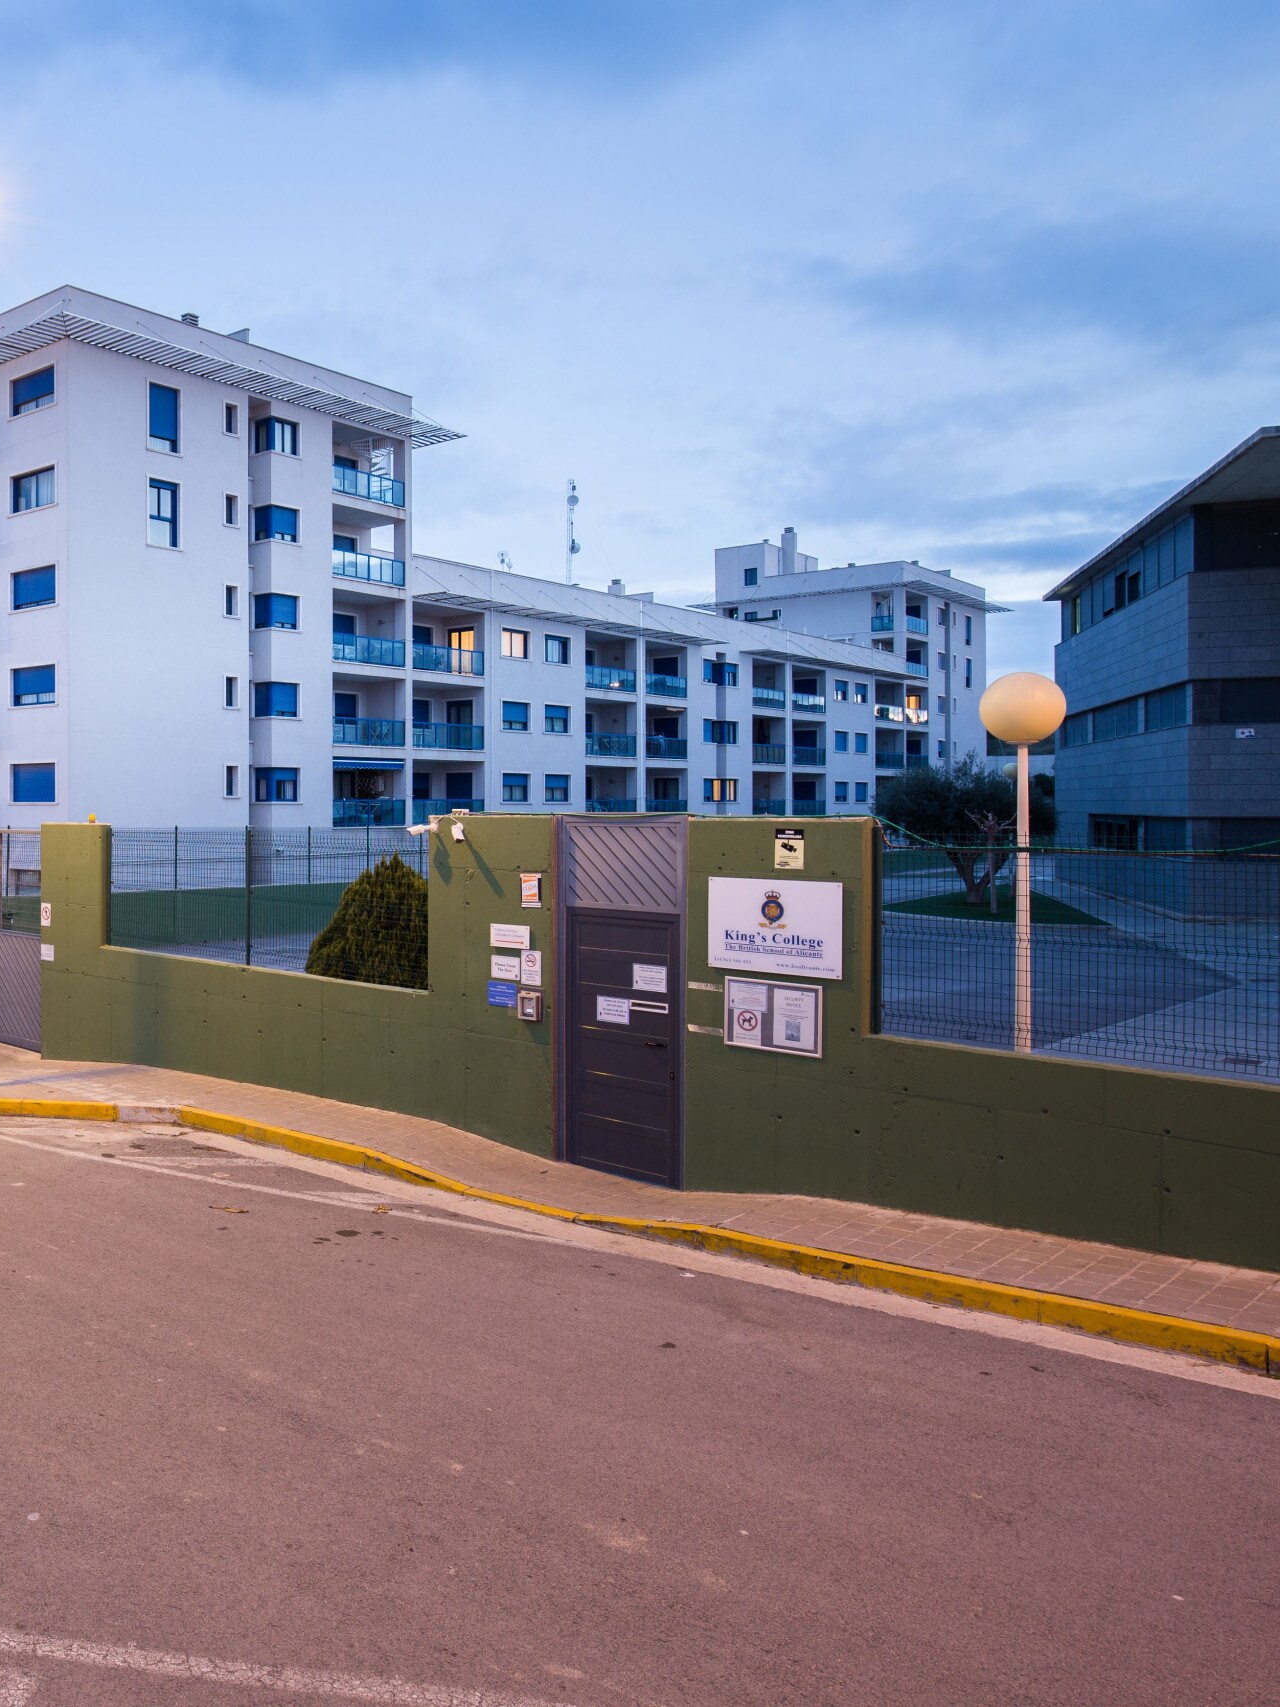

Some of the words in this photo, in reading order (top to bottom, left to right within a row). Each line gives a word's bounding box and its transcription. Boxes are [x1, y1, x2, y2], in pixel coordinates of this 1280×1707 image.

[725, 930, 767, 944] King's
[772, 933, 824, 949] College
[795, 950, 824, 958] Alicante
